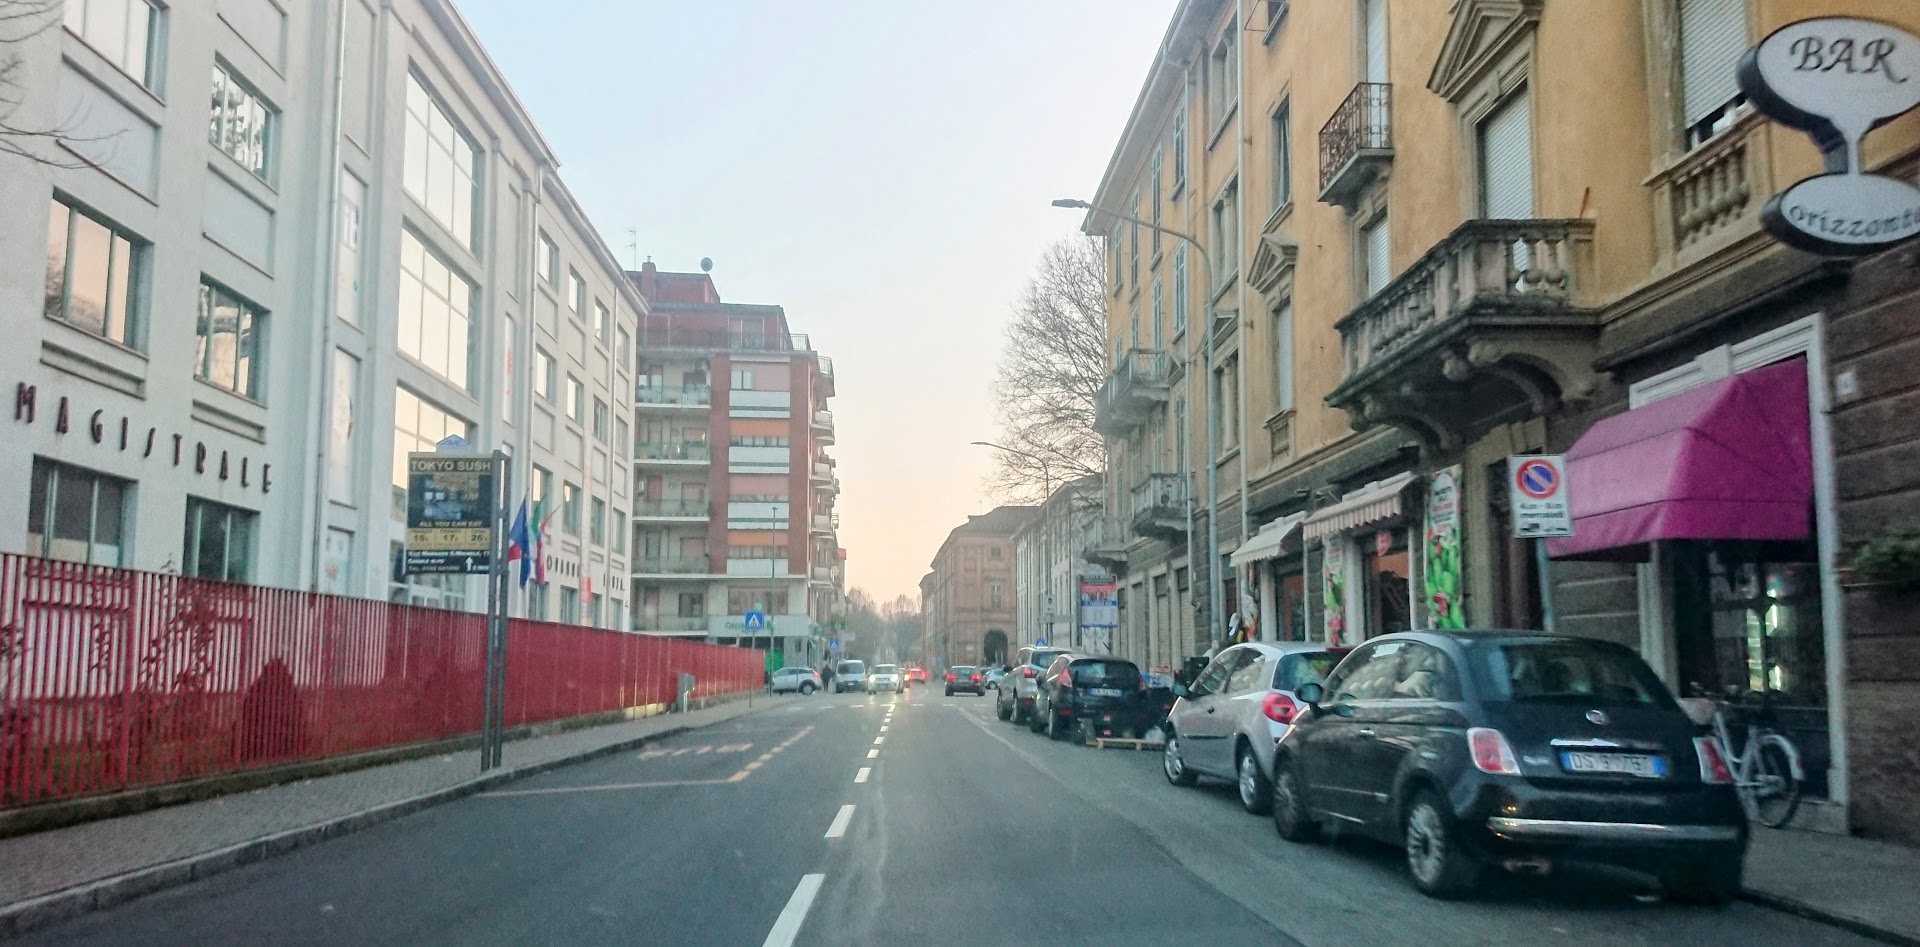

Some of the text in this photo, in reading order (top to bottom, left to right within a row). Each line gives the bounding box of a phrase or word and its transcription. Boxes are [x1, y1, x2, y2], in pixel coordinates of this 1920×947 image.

[1790, 36, 1908, 84] BAR
[15, 381, 272, 493] MAGISTRALE
[411, 460, 491, 471] TOKYO SUSH
